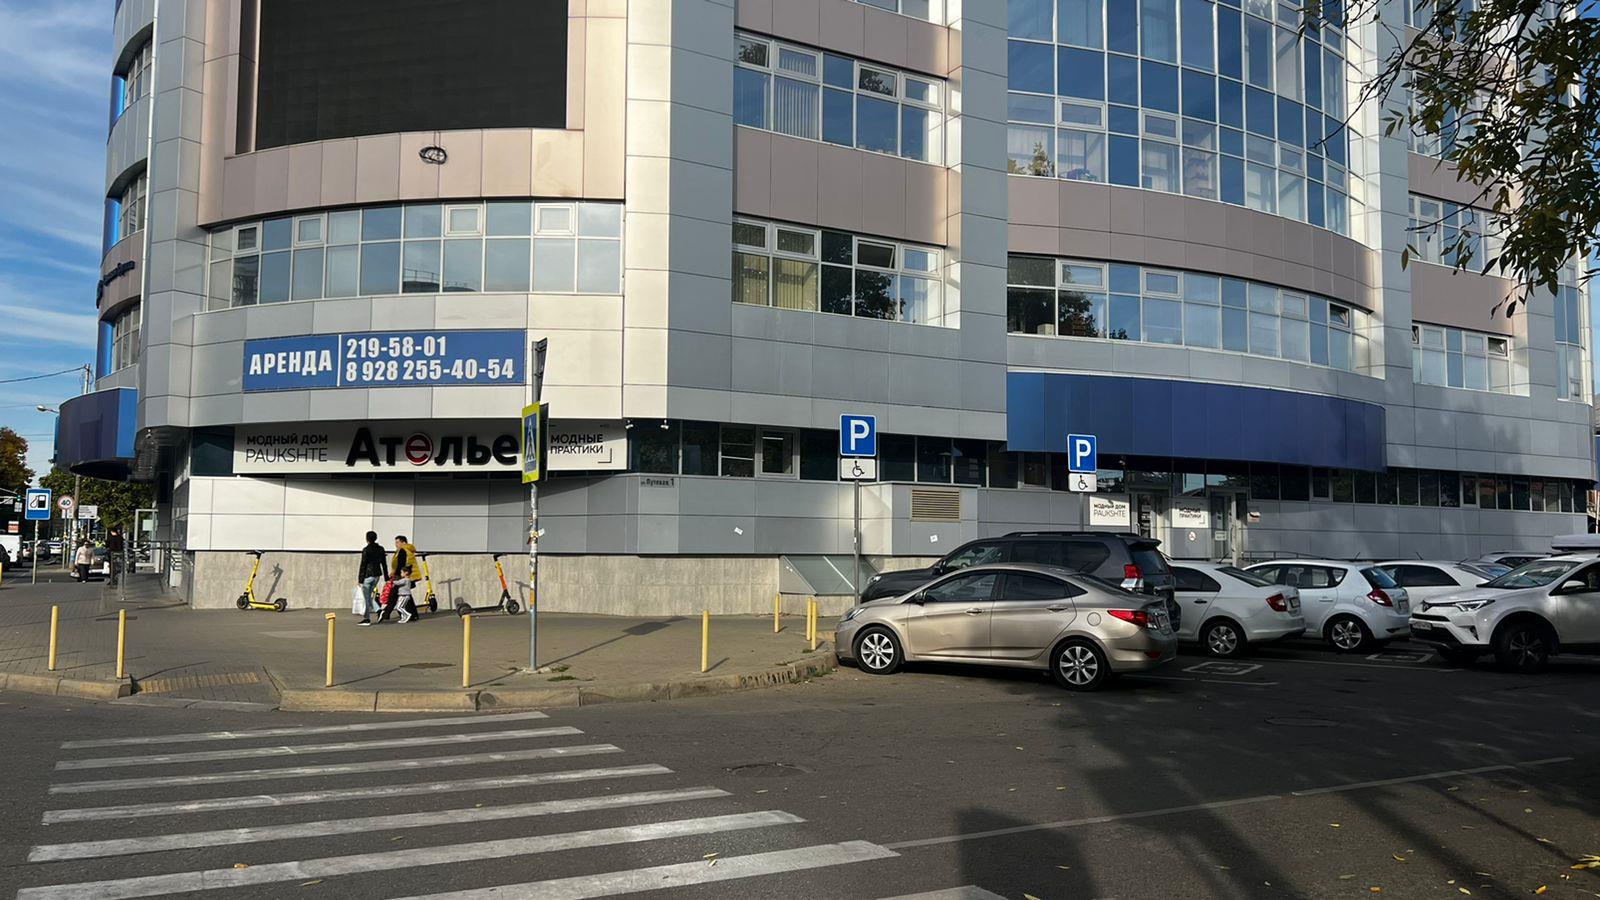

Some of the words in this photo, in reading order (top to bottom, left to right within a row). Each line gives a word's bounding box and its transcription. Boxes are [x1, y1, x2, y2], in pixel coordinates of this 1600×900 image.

[346, 336, 447, 358] 219-58-01
[249, 350, 332, 376] АРЕНДА
[345, 361, 358, 382] 8
[362, 360, 399, 381] 928
[402, 358, 514, 380] 255-40-54
[246, 433, 298, 446] МОДНЫЙ
[300, 434, 328, 446] ДОМ
[550, 433, 604, 444] МОДНЫЕ
[850, 420, 870, 451] P
[245, 448, 328, 463] PAUKSHTE
[345, 427, 520, 467] Ателье
[550, 444, 604, 454] ПРАКТИКИ
[1076, 439, 1091, 467] P
[1093, 508, 1126, 518] PAUKSHTE
